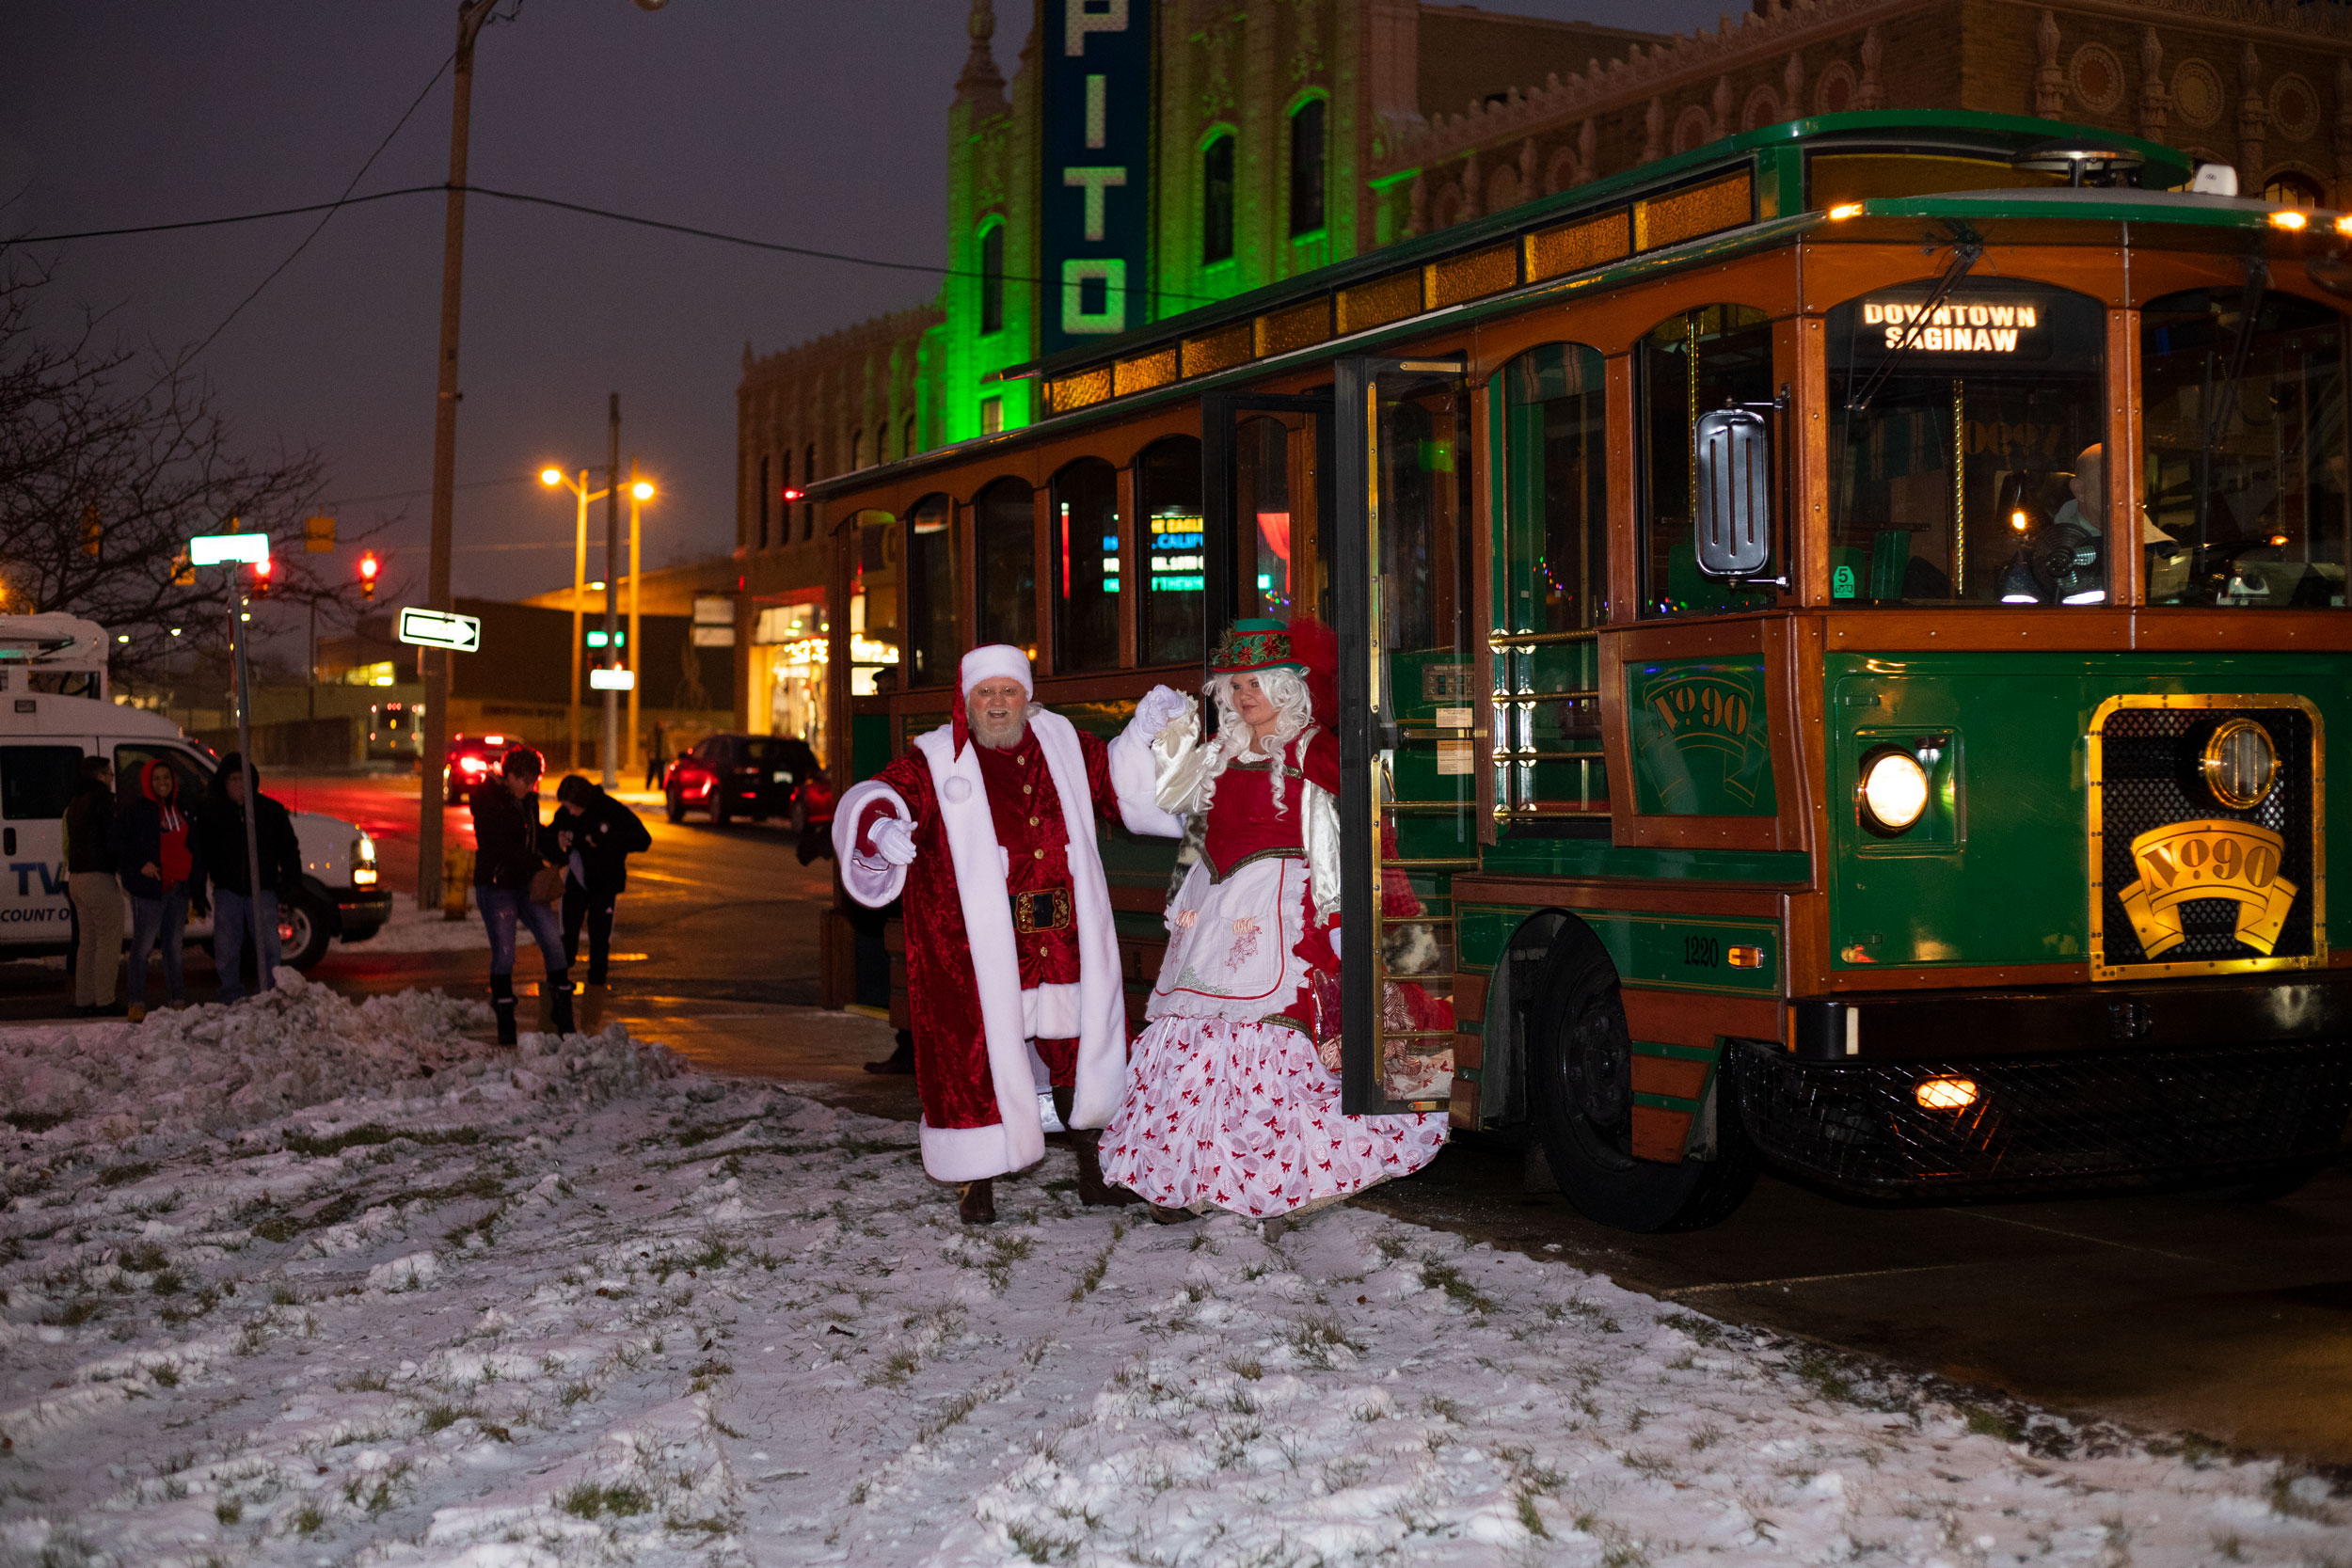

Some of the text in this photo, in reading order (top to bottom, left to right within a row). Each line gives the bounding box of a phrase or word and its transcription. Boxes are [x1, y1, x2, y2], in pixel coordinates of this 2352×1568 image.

[1864, 304, 2037, 327] DOWNTOWN
[1885, 326, 2018, 352] SAGINAW
[1838, 568, 1849, 582] 5
[0, 909, 55, 922] COUNT
[1684, 935, 1719, 968] 1220
